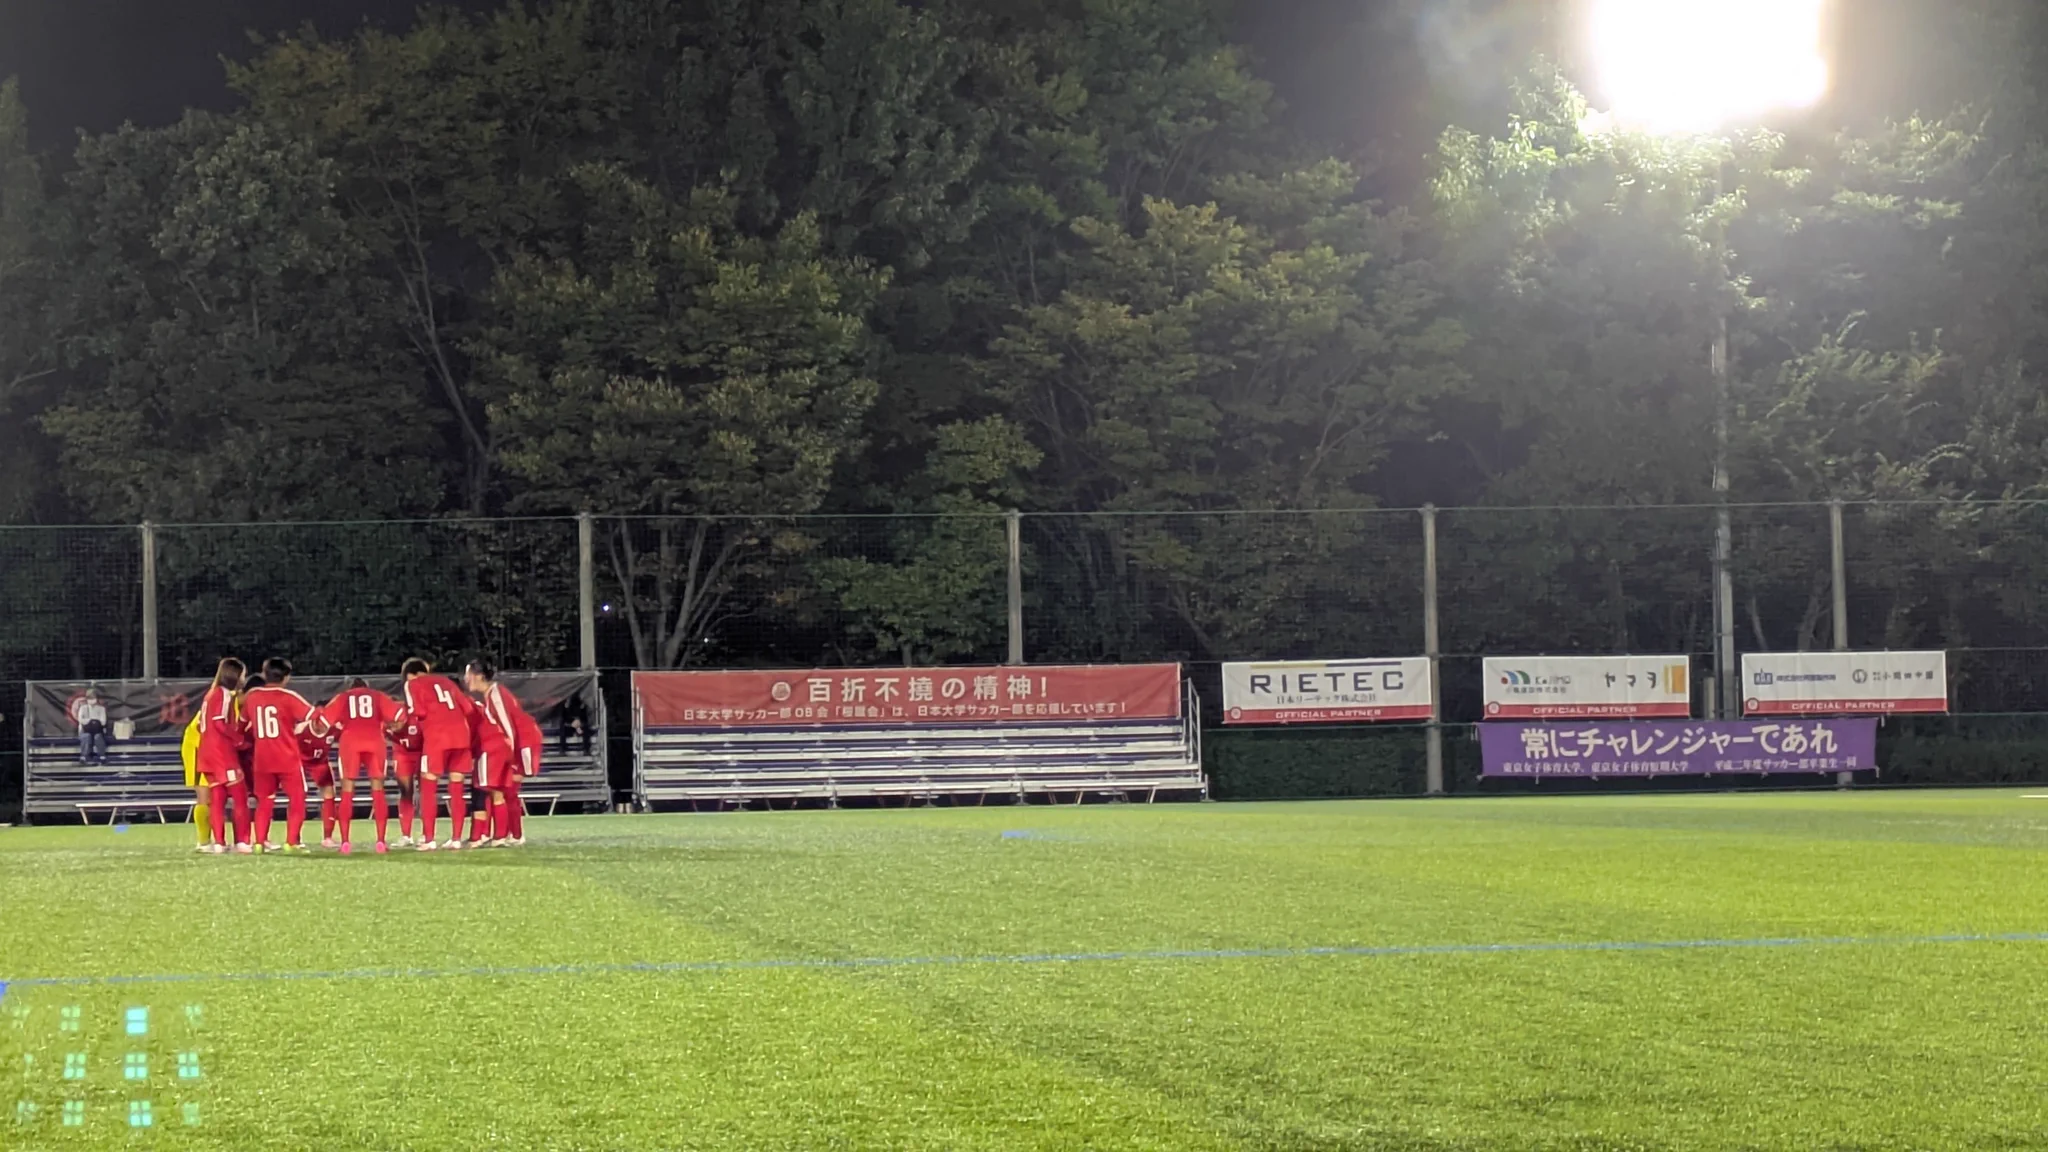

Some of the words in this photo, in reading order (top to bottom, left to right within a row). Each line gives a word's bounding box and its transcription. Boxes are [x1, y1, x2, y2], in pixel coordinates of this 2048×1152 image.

[1250, 671, 1404, 694] RIETEC
[349, 694, 373, 718] 18
[434, 683, 454, 710] 4
[1791, 702, 1841, 710] OFFICIAL
[1845, 701, 1896, 709] PARTNER
[256, 705, 279, 738] 16
[1276, 711, 1327, 719] OFFICIAL
[1330, 709, 1382, 717] PARTNER
[1521, 723, 1838, 760] 常にチャレンジャーであれ
